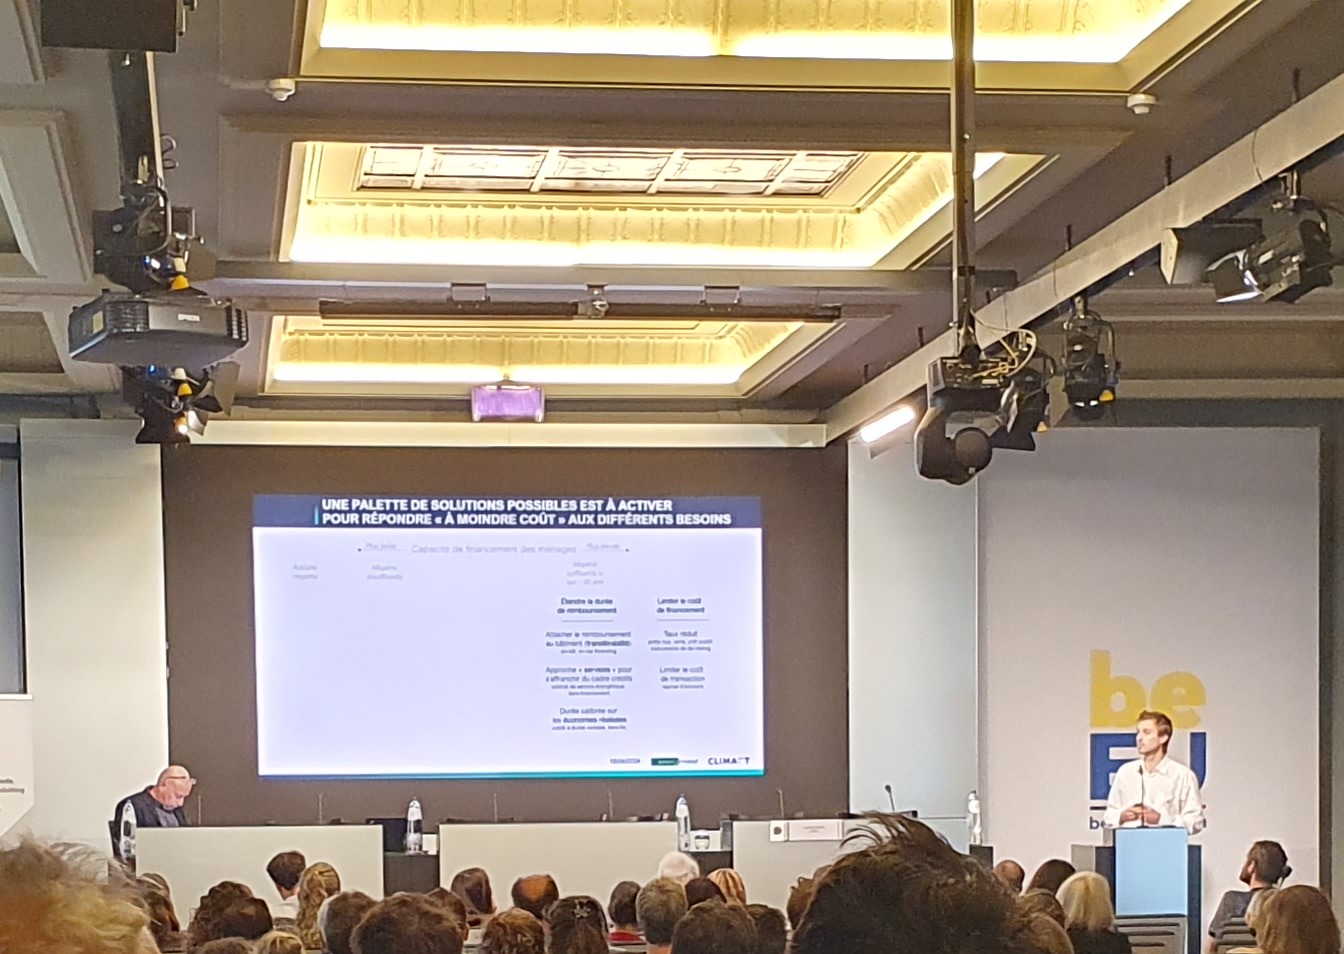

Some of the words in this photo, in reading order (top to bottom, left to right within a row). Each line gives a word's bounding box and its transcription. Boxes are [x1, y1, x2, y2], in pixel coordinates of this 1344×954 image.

[322, 499, 349, 510] UNE
[352, 499, 408, 510] PALETTE
[410, 499, 429, 510] DE
[431, 499, 505, 510] SOLUTIONS
[508, 499, 578, 510] POSSIBLES
[580, 499, 604, 510] EST
[606, 497, 616, 510] À
[618, 499, 673, 510] ACTIVER
[322, 514, 360, 525] POUR
[362, 510, 432, 525] RÉPONDRE
[444, 510, 454, 525] À
[456, 514, 517, 525] MOINDRE
[519, 512, 558, 525] COÛT
[568, 514, 595, 525] AUX
[597, 512, 674, 525] DIFFÉRENTS
[676, 514, 732, 525] BESOINS
[1089, 649, 1206, 729] be
